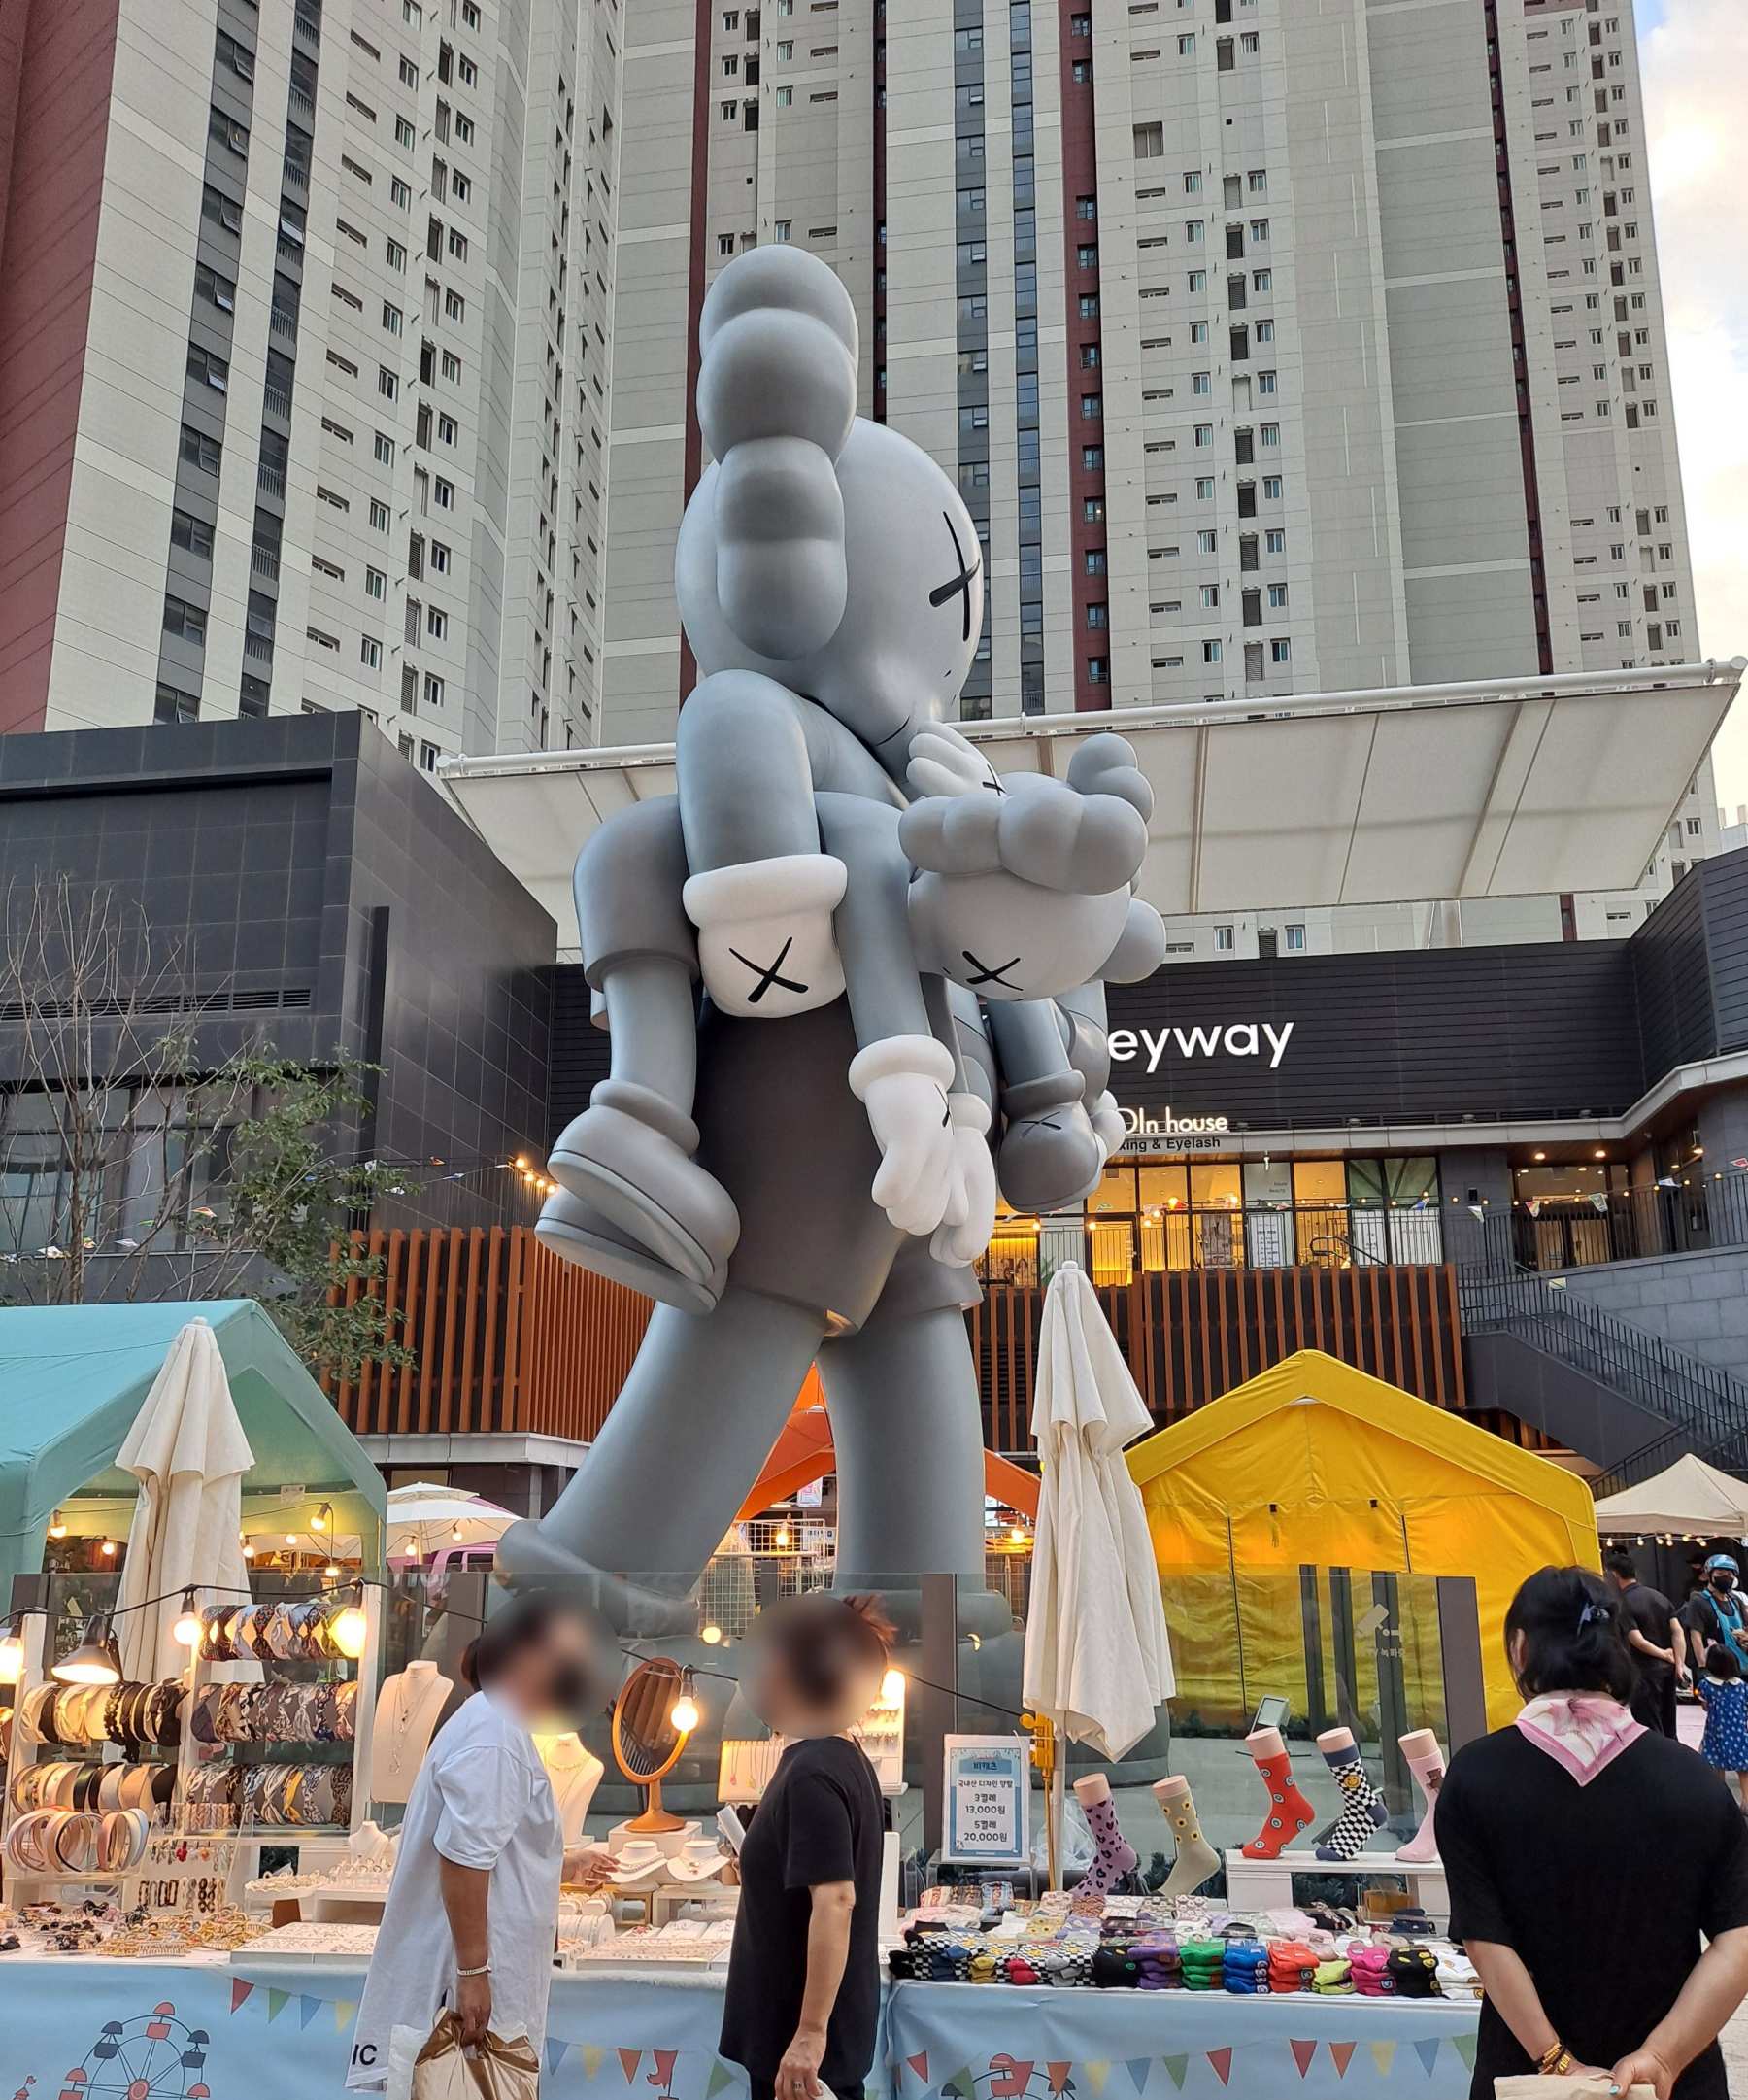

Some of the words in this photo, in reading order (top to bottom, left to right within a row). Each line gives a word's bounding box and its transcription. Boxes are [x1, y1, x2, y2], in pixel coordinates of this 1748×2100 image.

[1165, 1105, 1228, 1134] house
[1152, 1138, 1161, 1150] &
[1166, 1136, 1221, 1151] Eyelash
[958, 1779, 977, 1788] 국내산
[978, 1779, 998, 1788] 디자인
[999, 1779, 1013, 1788] 양말
[974, 1793, 997, 1804] 3켤레
[974, 1820, 997, 1831] 5켤레
